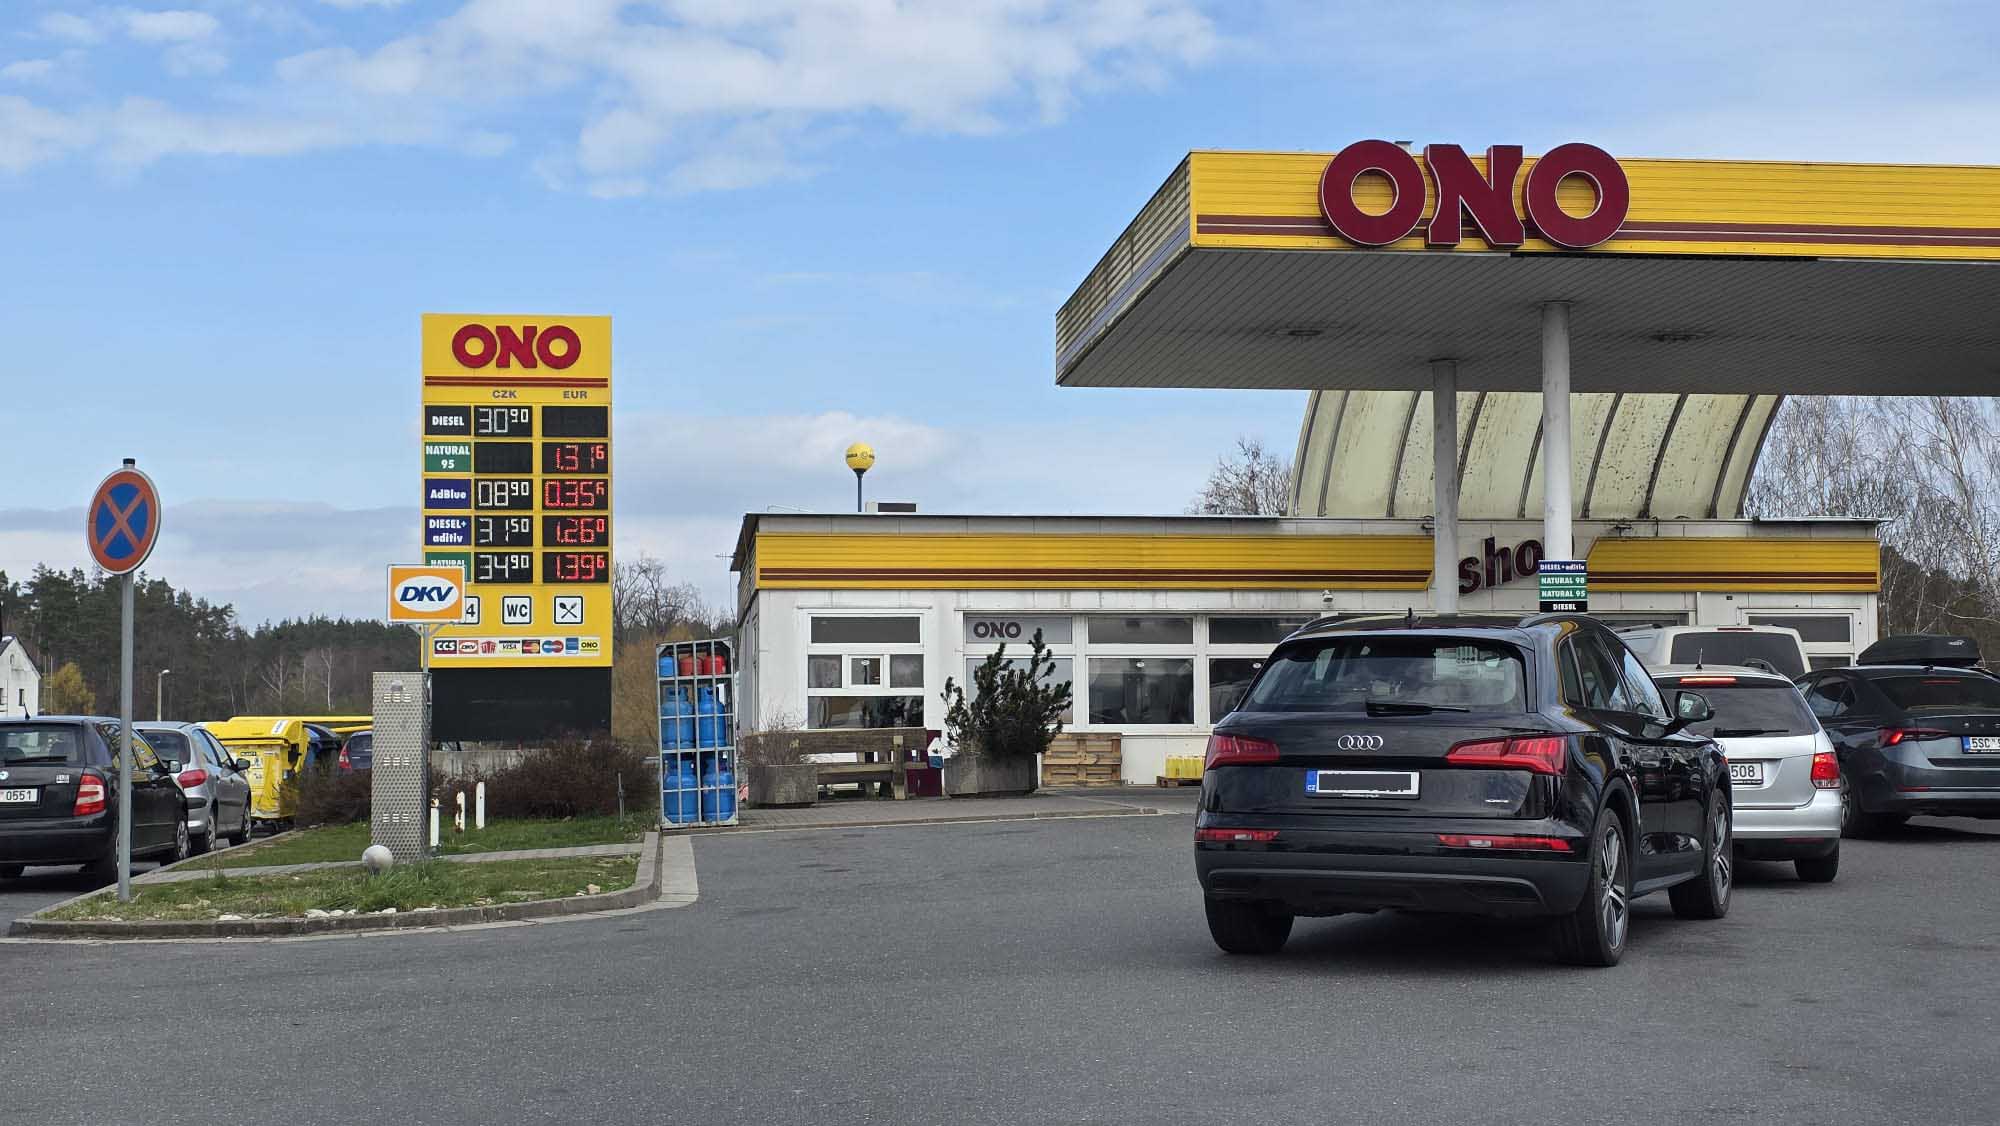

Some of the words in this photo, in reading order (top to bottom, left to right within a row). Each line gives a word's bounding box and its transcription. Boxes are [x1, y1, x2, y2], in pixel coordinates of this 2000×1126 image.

[1318, 139, 1630, 249] ONO
[452, 324, 581, 369] ONO
[492, 390, 517, 399] CZK
[563, 390, 588, 399] EUR
[432, 416, 464, 426] DIESEL
[425, 445, 471, 455] NATURAL
[441, 459, 455, 469] 95
[430, 489, 467, 499] AdBlue
[432, 532, 463, 543] aditiv
[1459, 536, 1574, 594] sho
[400, 586, 453, 602] DKV
[466, 603, 475, 617] 4
[506, 604, 528, 617] WC
[973, 621, 1021, 638] ONO
[436, 642, 455, 651] CCS
[1730, 765, 1756, 778] 508
